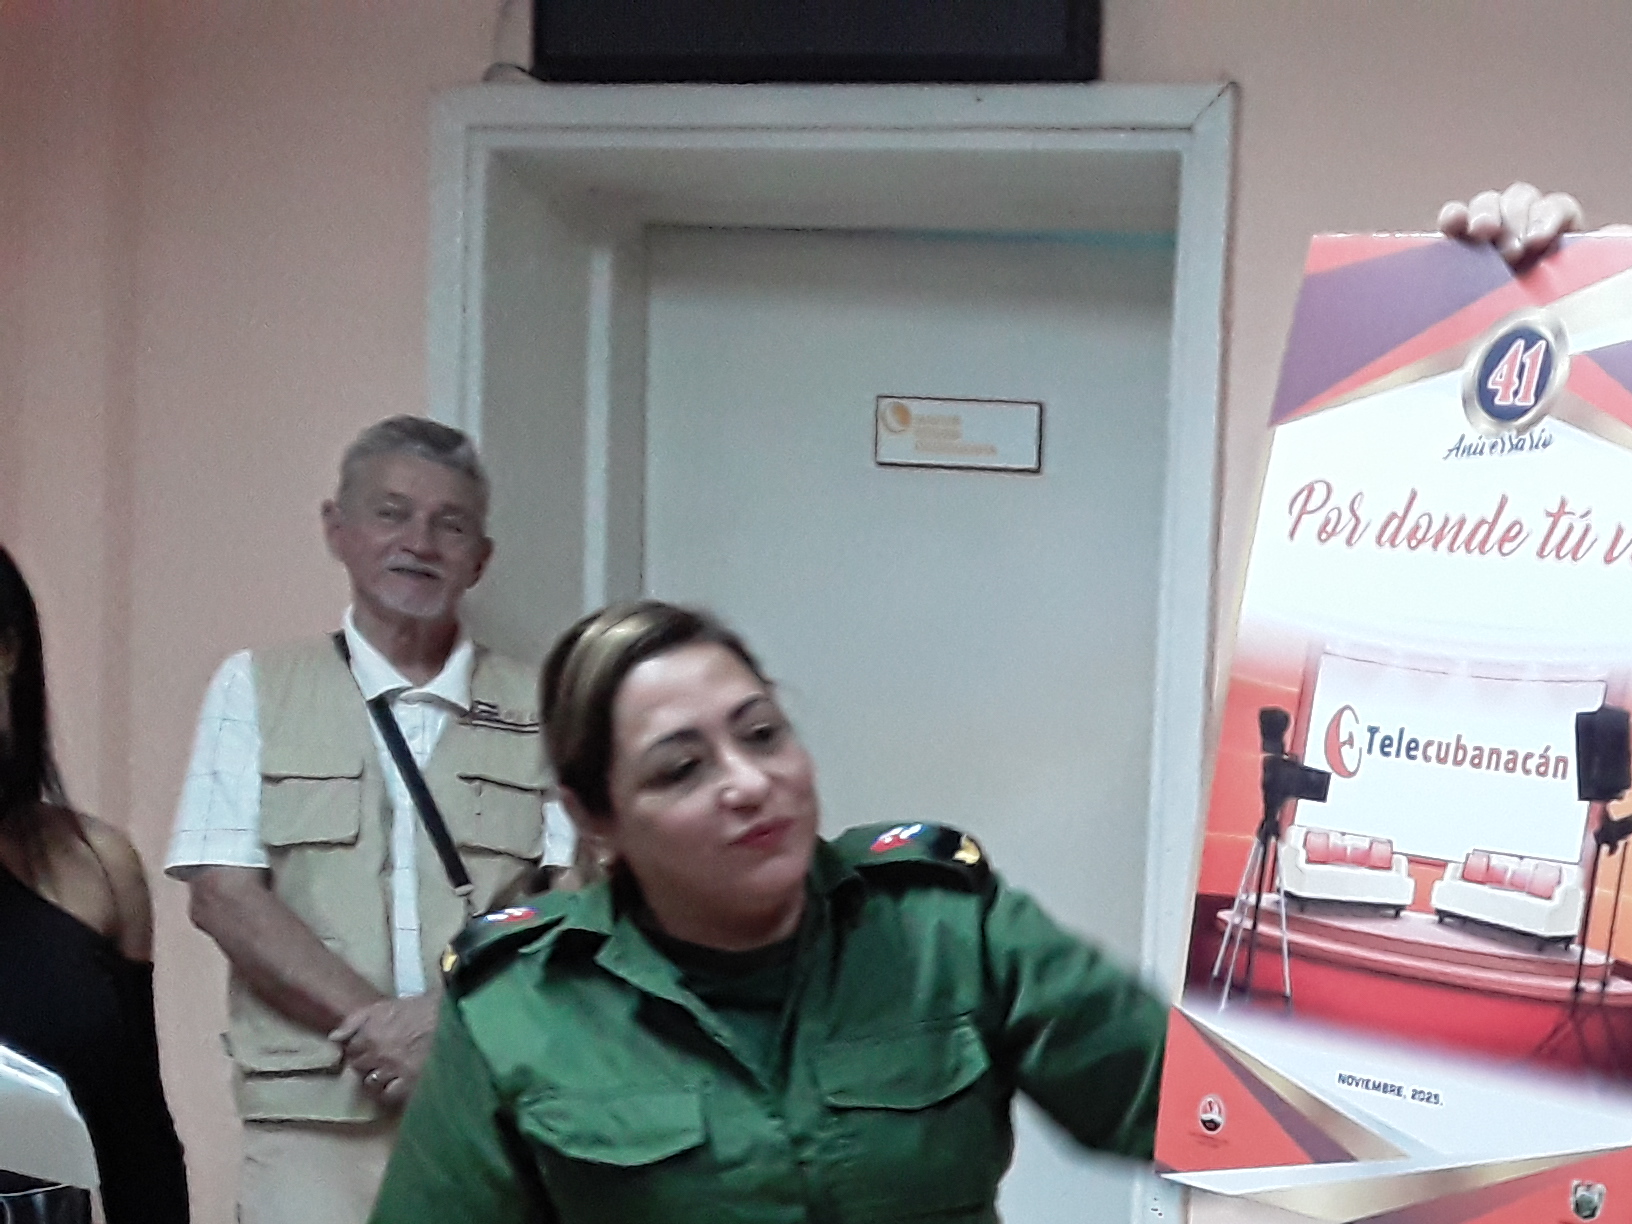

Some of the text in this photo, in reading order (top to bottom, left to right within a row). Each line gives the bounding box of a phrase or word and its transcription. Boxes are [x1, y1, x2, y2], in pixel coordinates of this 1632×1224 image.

[1487, 338, 1547, 406] 41
[1288, 479, 1373, 547] Por
[1375, 487, 1532, 557] donde
[1536, 495, 1598, 562] tú
[1366, 725, 1570, 780] Telecubanacán
